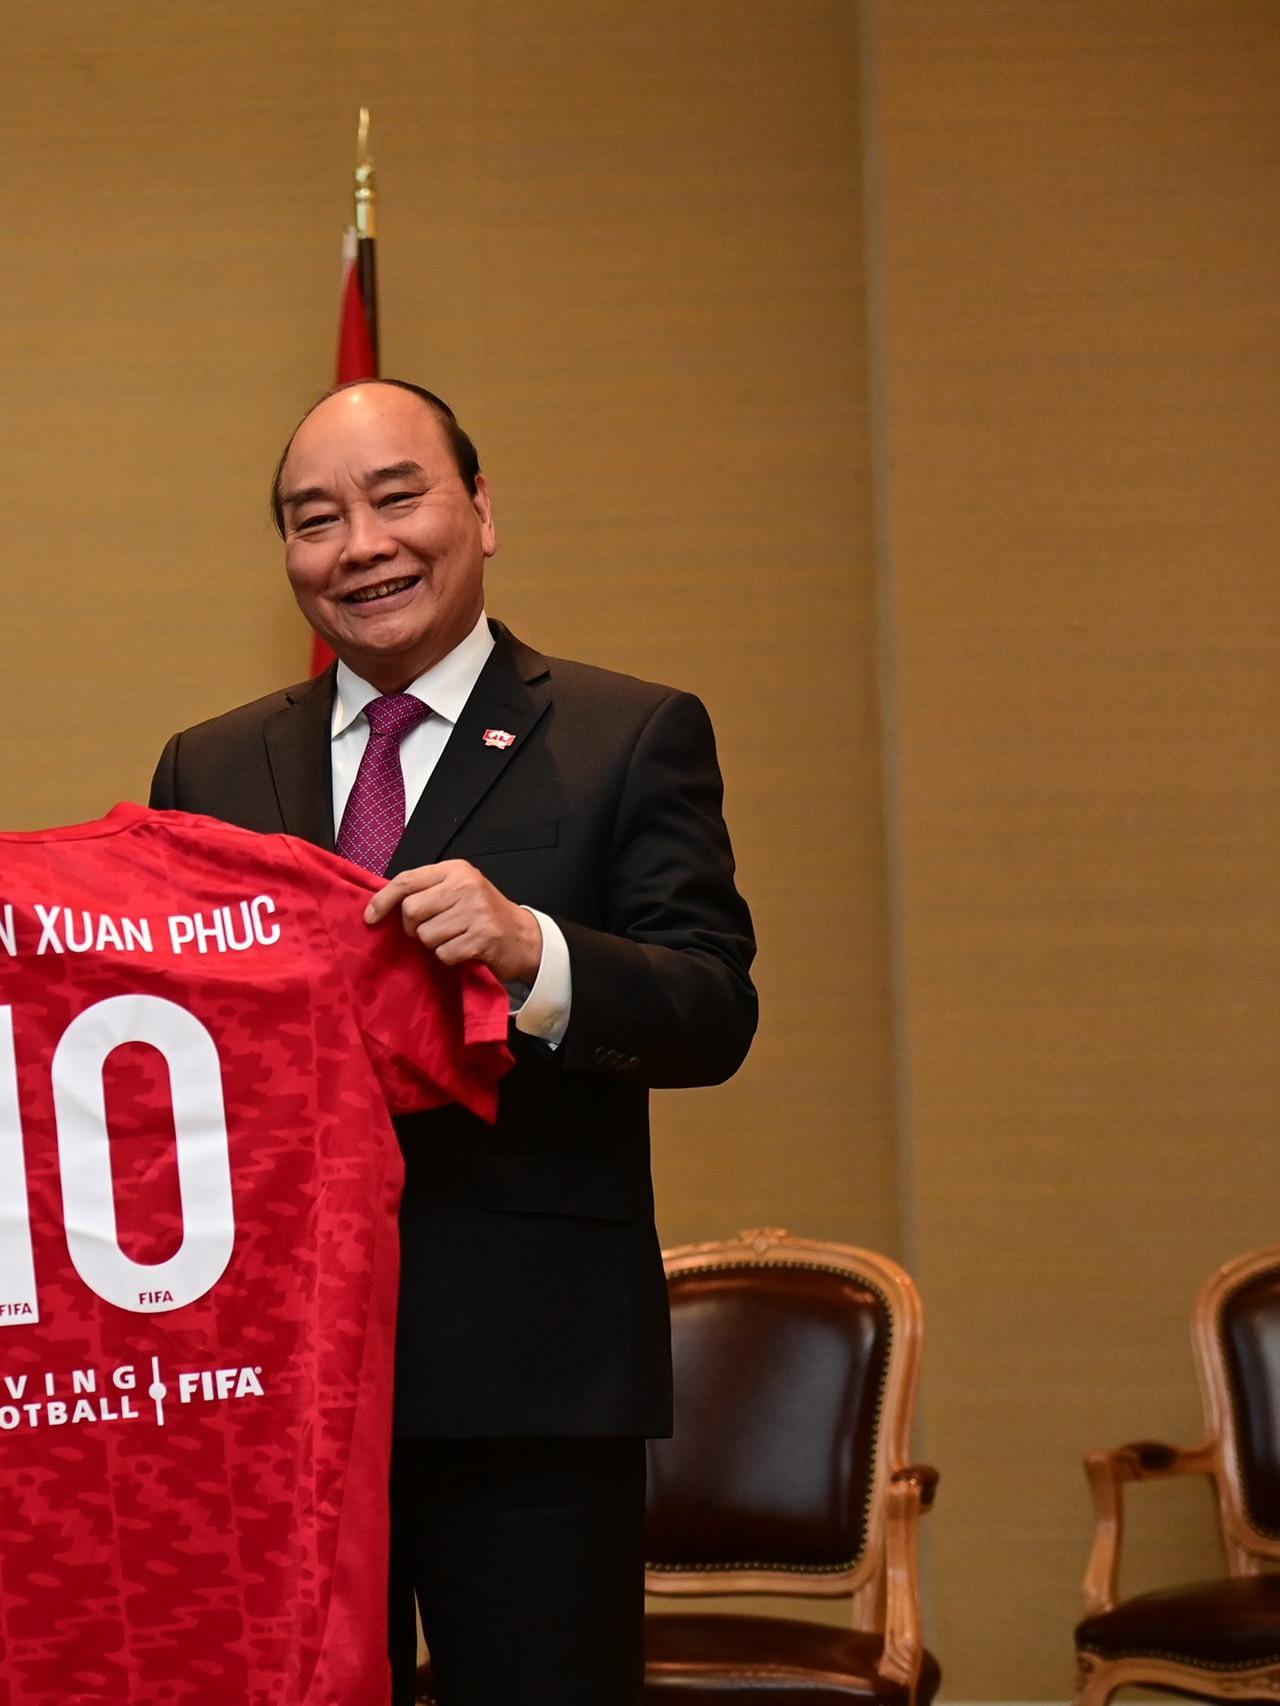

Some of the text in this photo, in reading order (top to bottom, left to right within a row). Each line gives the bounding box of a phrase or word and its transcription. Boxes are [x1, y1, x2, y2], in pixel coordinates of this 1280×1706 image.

[34, 903, 154, 955] XUAN
[167, 895, 281, 955] PHUC
[137, 1290, 174, 1305] FIFA
[178, 1367, 265, 1403] FIFA
